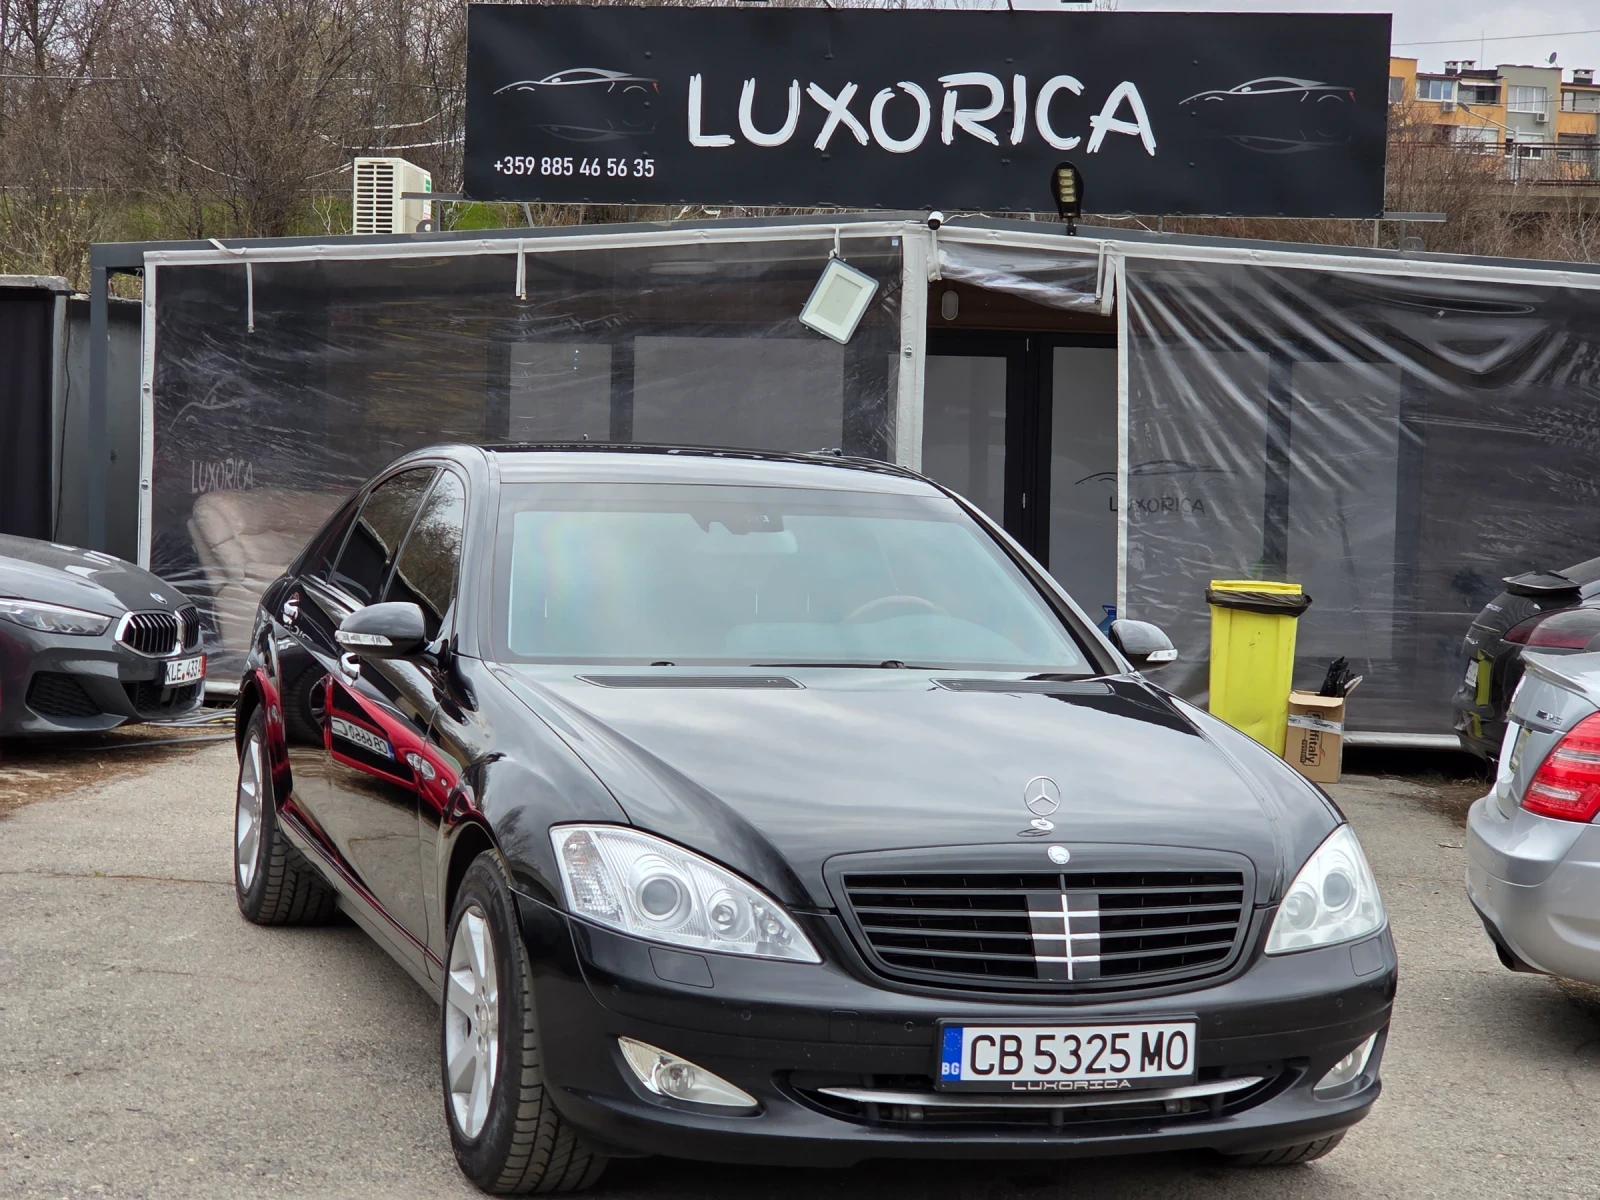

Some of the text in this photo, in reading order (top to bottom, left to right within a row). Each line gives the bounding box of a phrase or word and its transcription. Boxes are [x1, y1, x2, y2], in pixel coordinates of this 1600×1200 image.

[687, 72, 1156, 156] LUXORICA
[493, 155, 655, 178] +359 885 46 56 35
[190, 457, 254, 494] LUXORICA
[1109, 495, 1206, 514] LXORICA
[164, 662, 183, 683] KLE
[941, 1029, 1189, 1076] BG CB 5325 MO
[1011, 1079, 1132, 1091] LUXORICA
